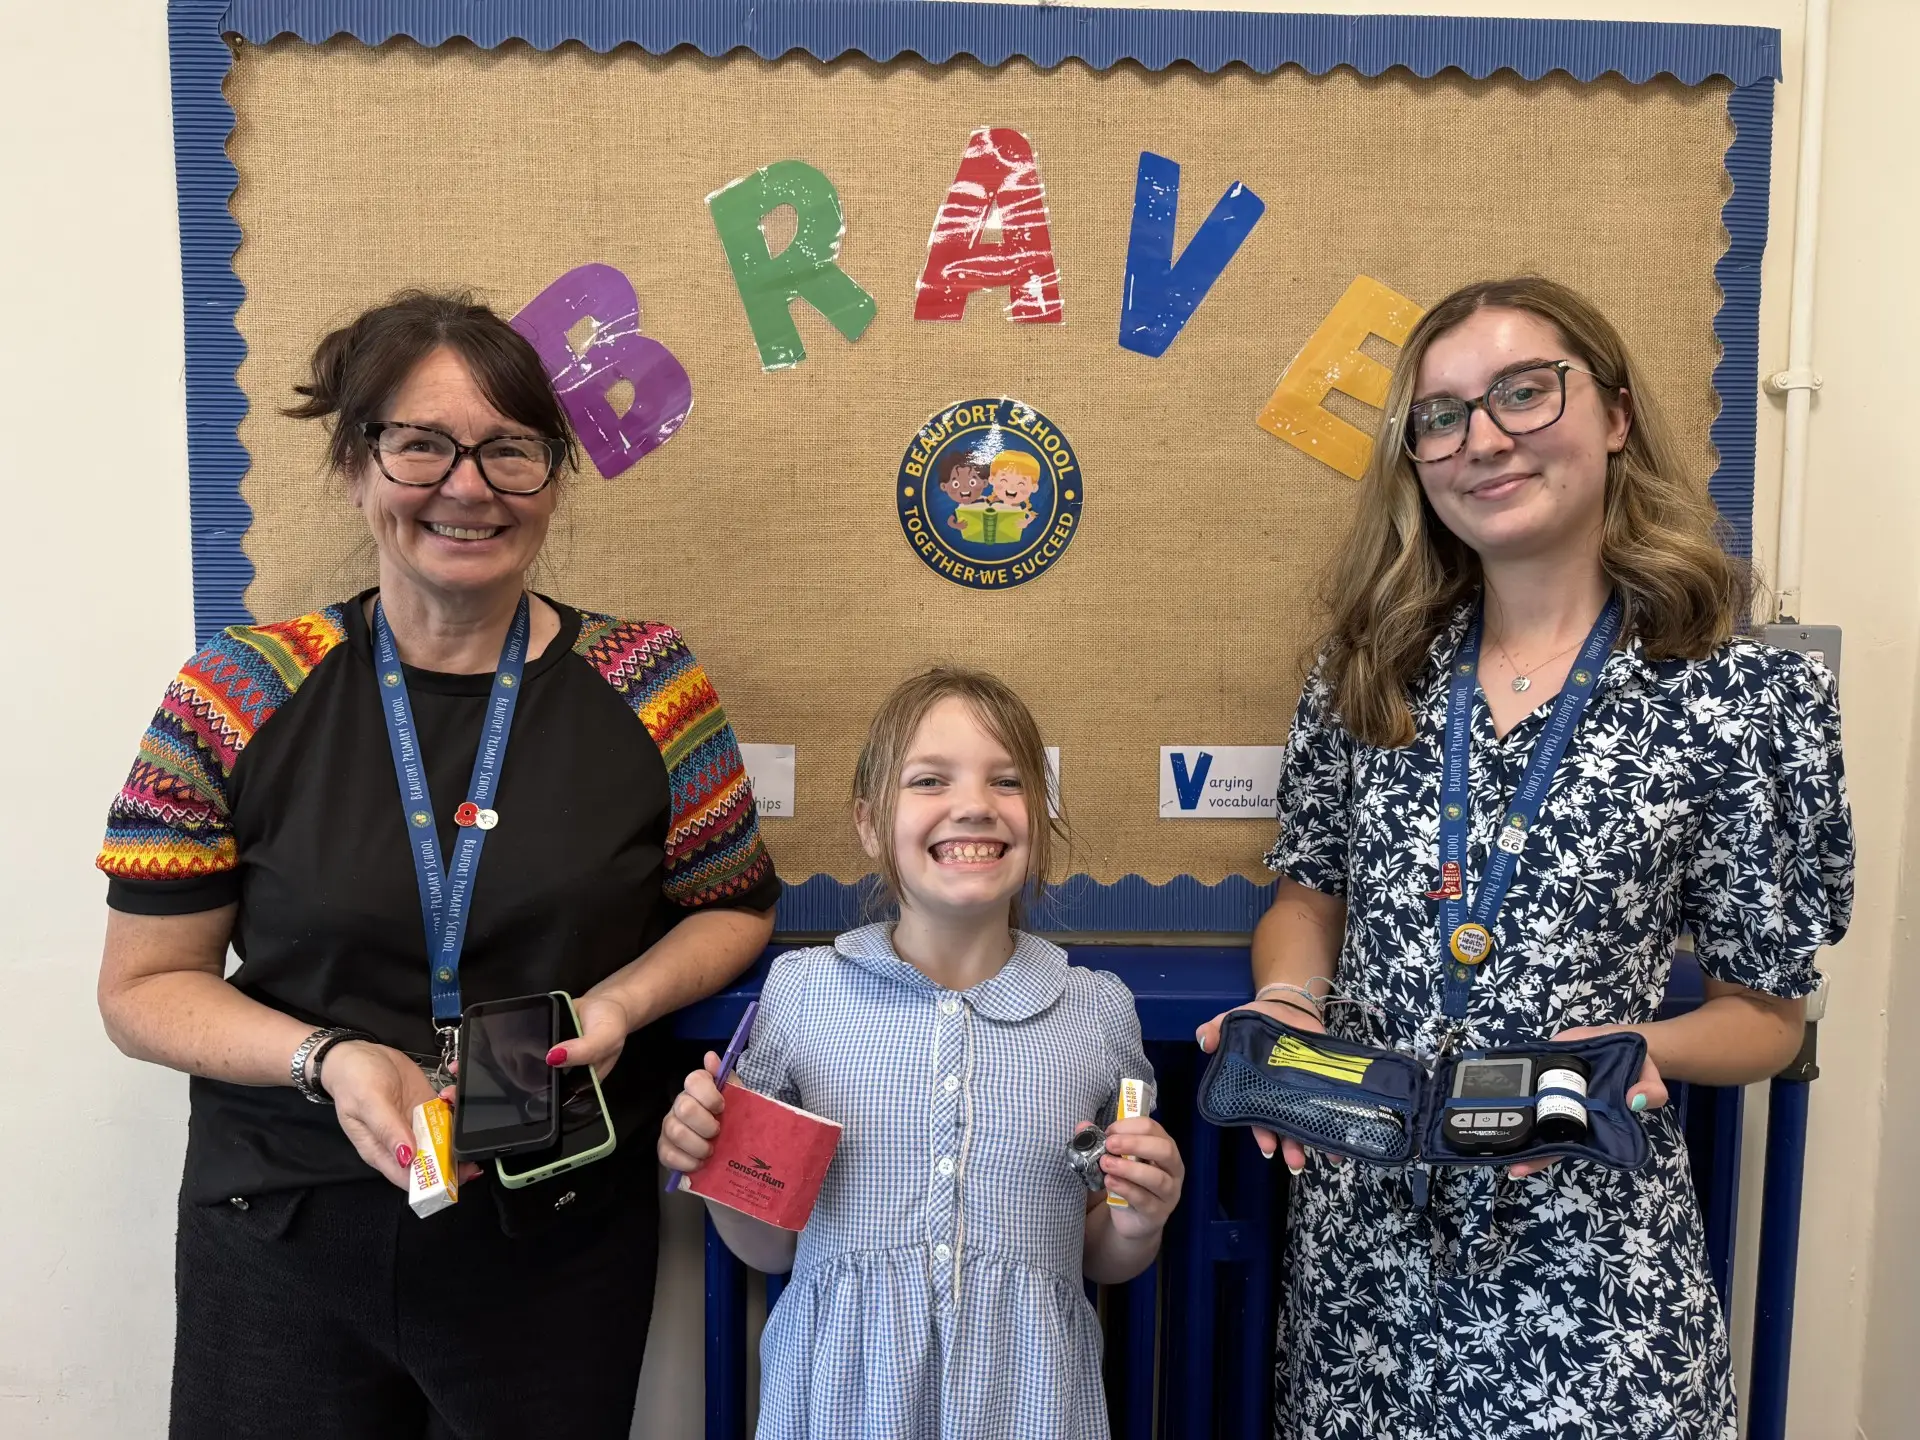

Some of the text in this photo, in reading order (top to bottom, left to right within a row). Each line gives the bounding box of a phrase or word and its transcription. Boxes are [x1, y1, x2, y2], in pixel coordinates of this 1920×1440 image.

[904, 404, 1075, 480] BEAUFORT SCHOOL
[904, 505, 1074, 585] TOGETHER WE SUCCEED
[379, 628, 394, 663] BEAUFORT
[507, 635, 523, 663] SCHOOL
[1585, 632, 1608, 660] SCHOOL
[392, 696, 424, 801] BEAUFORT PRIMARY SCHOOL
[474, 697, 510, 800] BEAUFORT PRIMARY SCHOOL
[1448, 686, 1468, 793] BEAUFORT PRIMARY SCHOOL
[1520, 693, 1579, 801] BEAUFORT PRIMARY SCHOOL
[1208, 794, 1276, 808] vocabular
[420, 838, 437, 869] SCHOOL
[1501, 838, 1521, 851] 66
[426, 872, 443, 909] PRIMARY
[441, 839, 477, 953] BEAUFORT PRIMARY SCHOOL
[1476, 881, 1500, 921] PRIMARY
[1461, 937, 1484, 948] Health
[1463, 930, 1485, 942] Mental
[413, 1158, 429, 1191] DEXTRO
[422, 1154, 440, 1188] ENERGY
[728, 1159, 785, 1189] consortium
